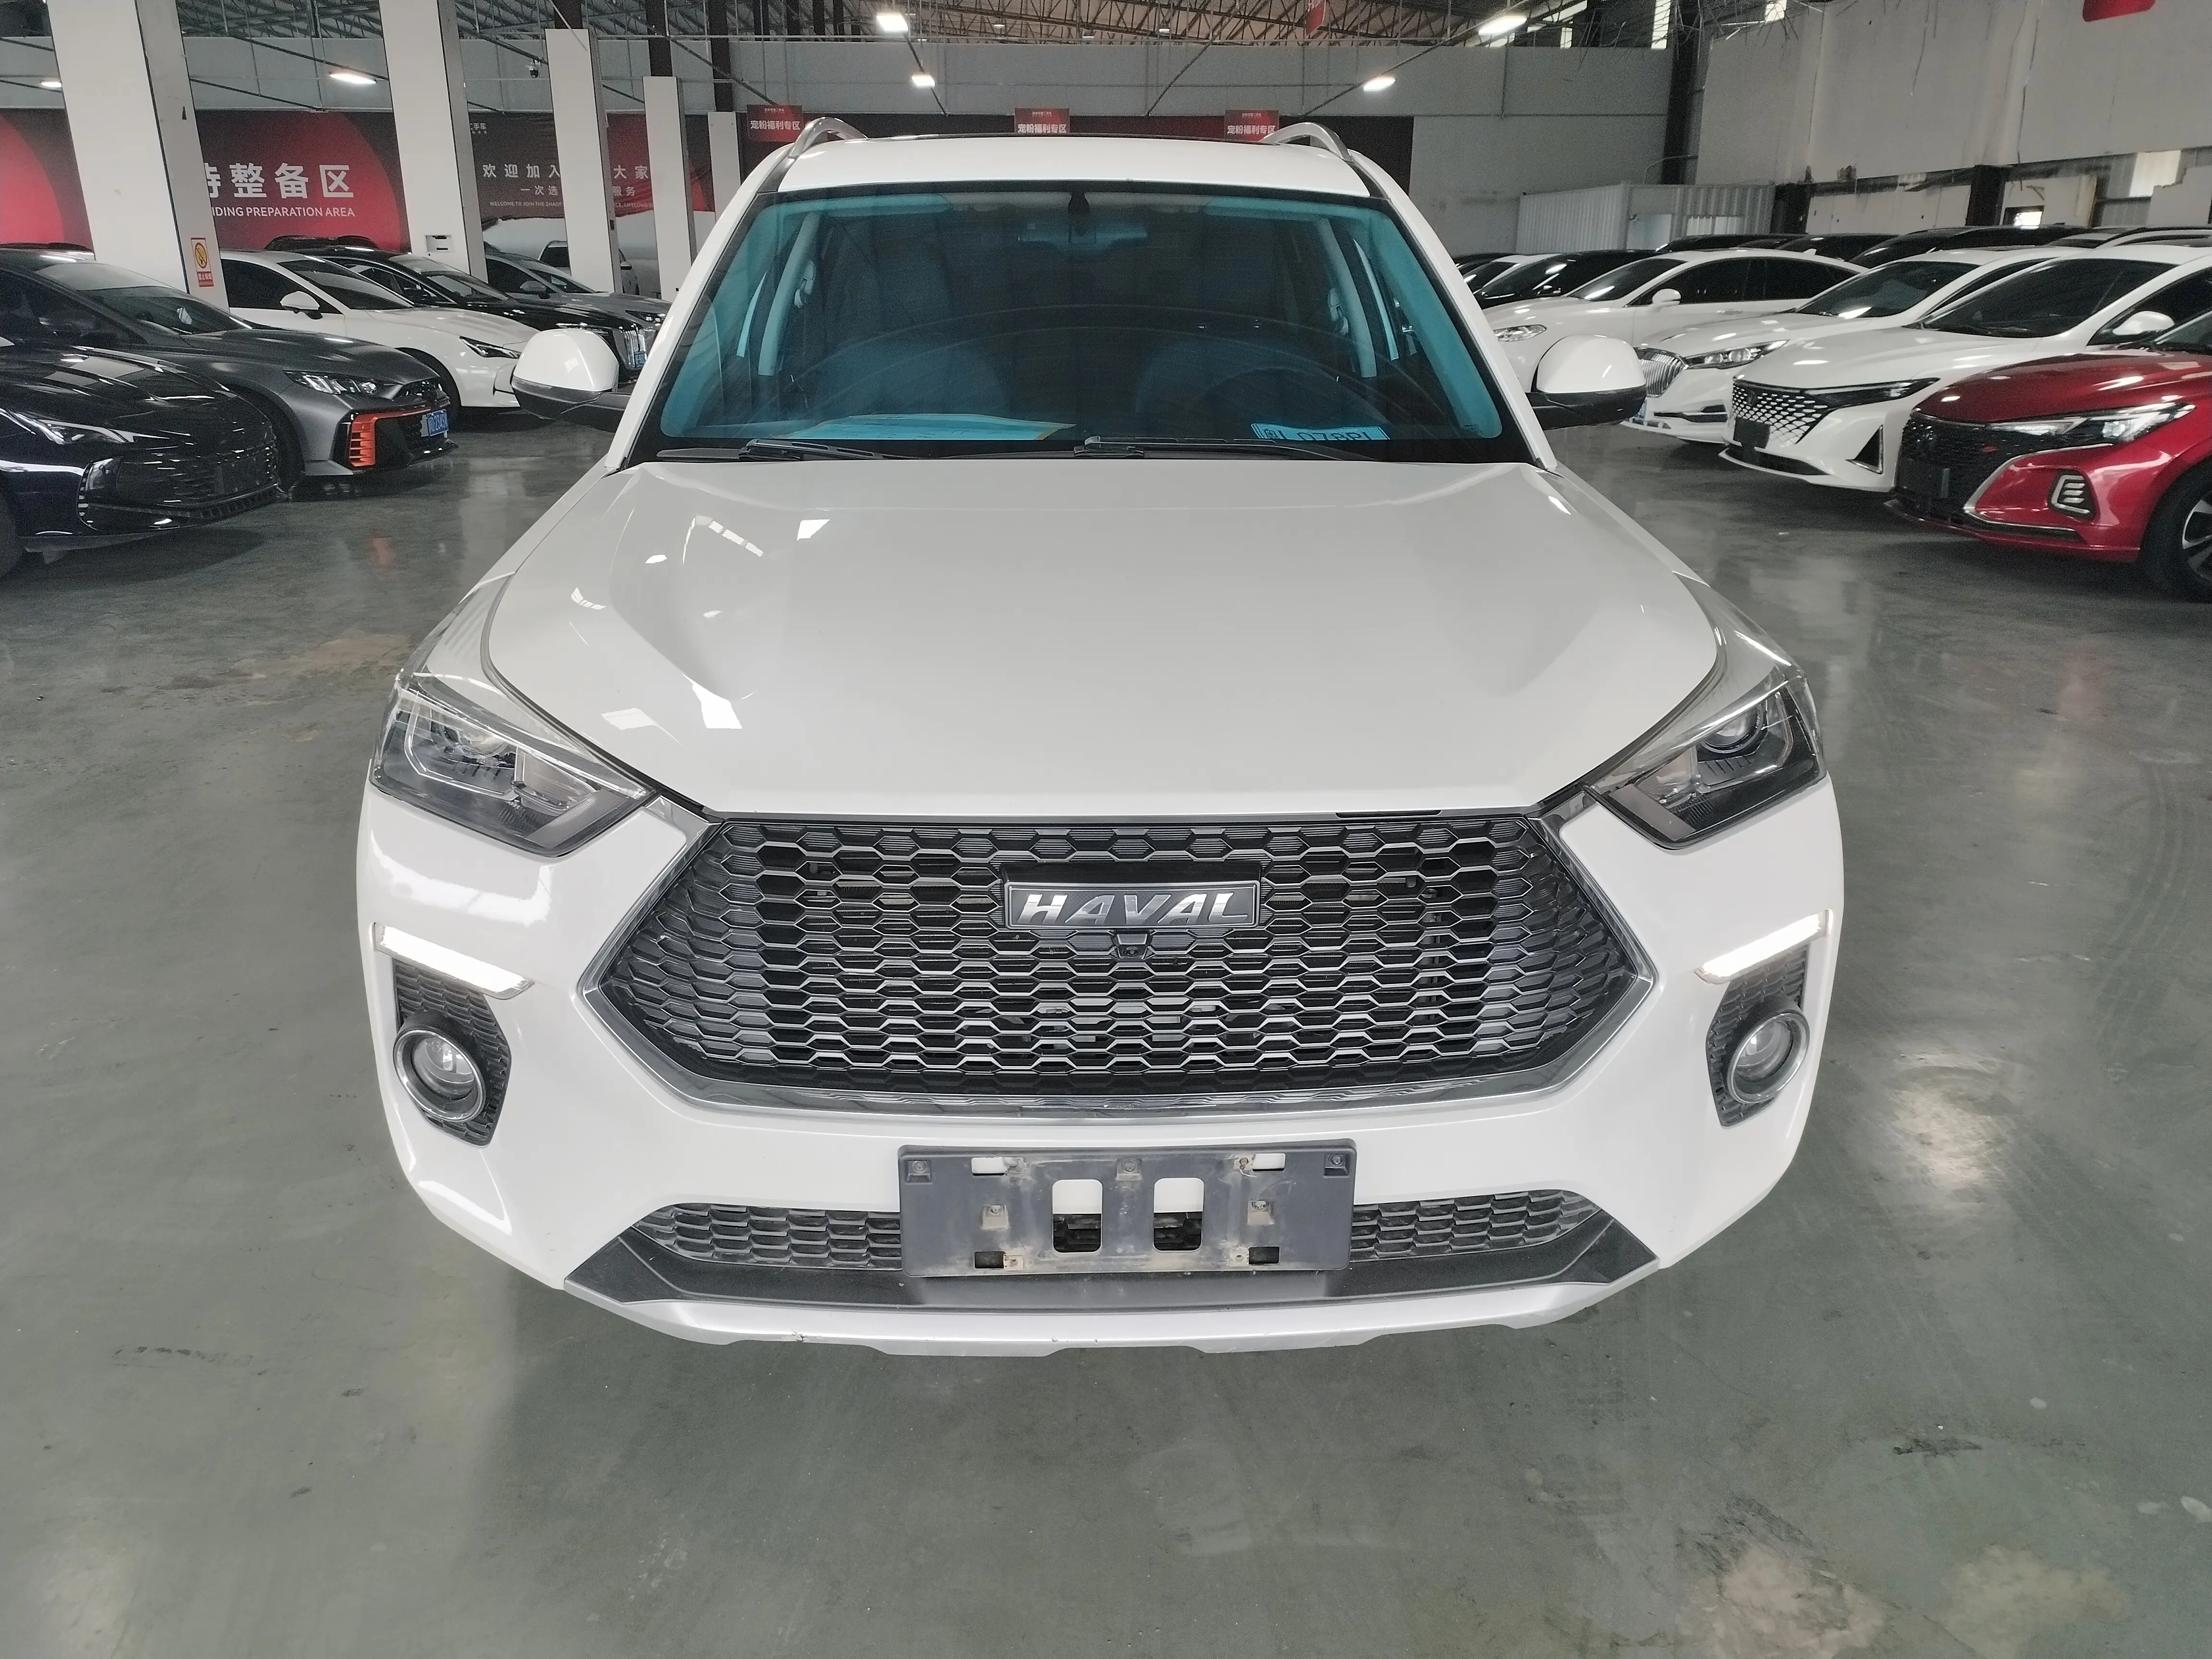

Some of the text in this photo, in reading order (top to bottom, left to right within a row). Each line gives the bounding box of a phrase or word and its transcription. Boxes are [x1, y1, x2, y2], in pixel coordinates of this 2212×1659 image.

[750, 120, 800, 130] 宠粉福利专区
[1018, 123, 1067, 133] 宠粉福利专区
[1227, 125, 1276, 134] 宠粉福利专区
[482, 164, 560, 178] 欢迎加入
[613, 165, 648, 179] 大家
[212, 207, 355, 216] DING PREPARATION AREA
[1016, 892, 1249, 925] HAVAL
